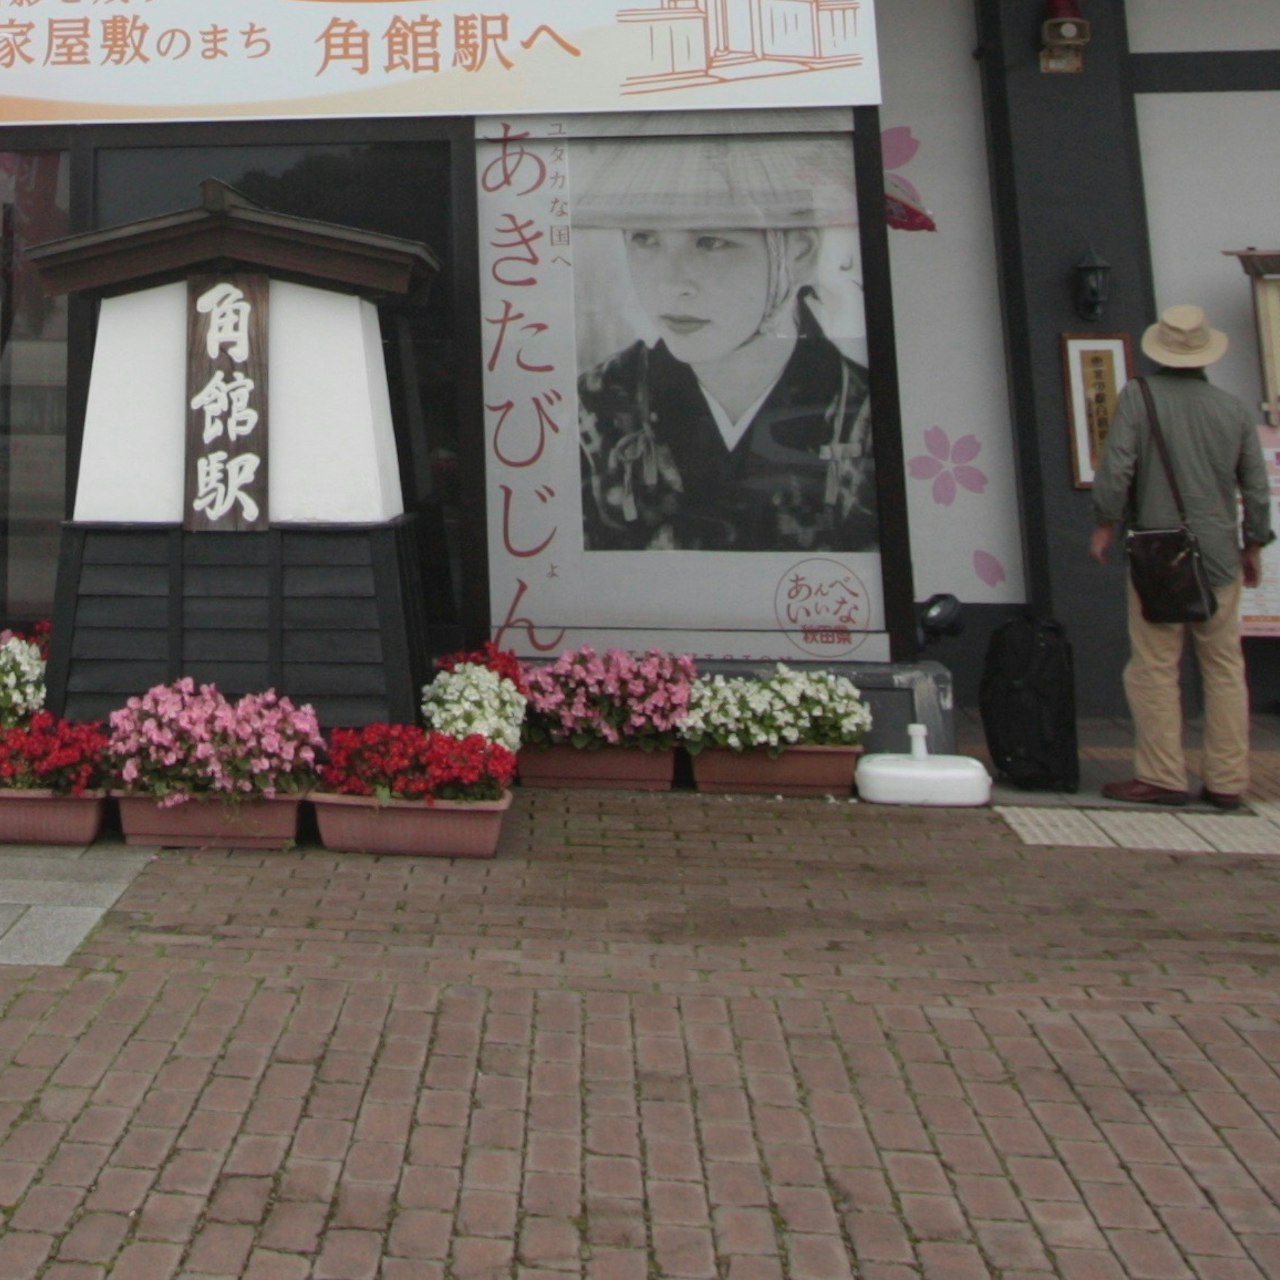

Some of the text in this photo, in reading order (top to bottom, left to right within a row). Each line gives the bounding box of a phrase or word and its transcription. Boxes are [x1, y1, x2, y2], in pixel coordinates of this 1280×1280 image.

[315, 12, 581, 77] 角館駅へ
[548, 122, 572, 267] ユタカな国へ
[190, 283, 262, 522] 角館駅
[801, 625, 852, 645] 秋田県
